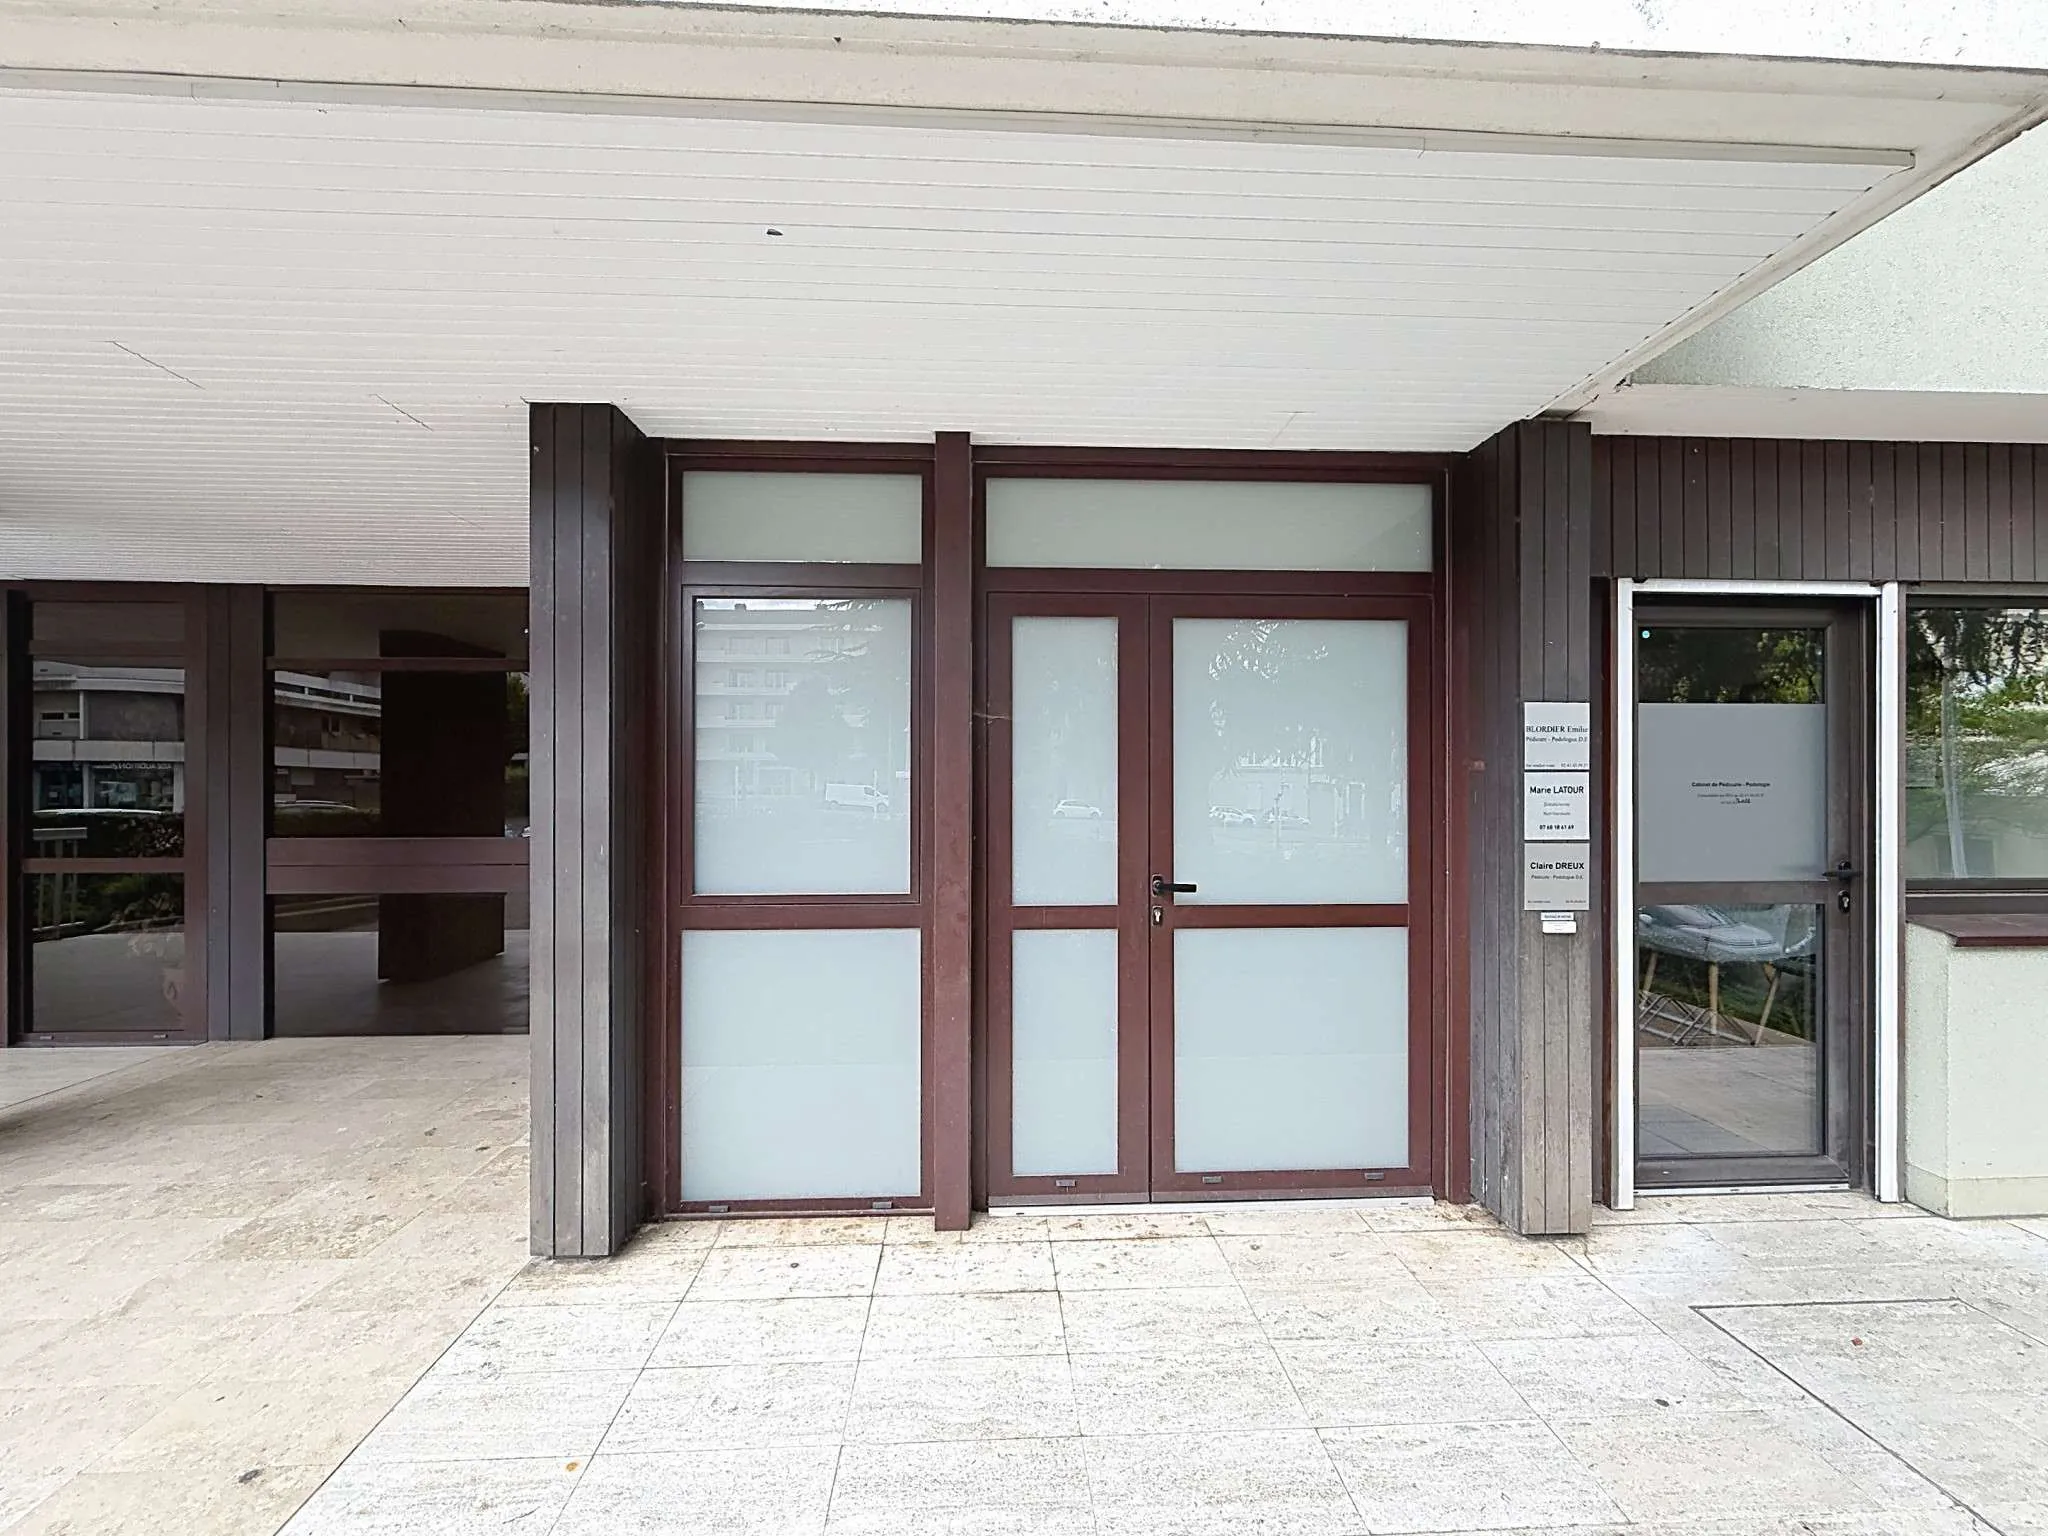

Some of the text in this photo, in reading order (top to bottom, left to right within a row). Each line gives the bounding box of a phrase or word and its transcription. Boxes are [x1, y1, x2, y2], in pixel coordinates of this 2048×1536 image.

[1526, 725, 1565, 733] BLORDIER
[1530, 785, 1584, 794] Marie LATOUR
[1530, 862, 1585, 870] Claire DREUX
